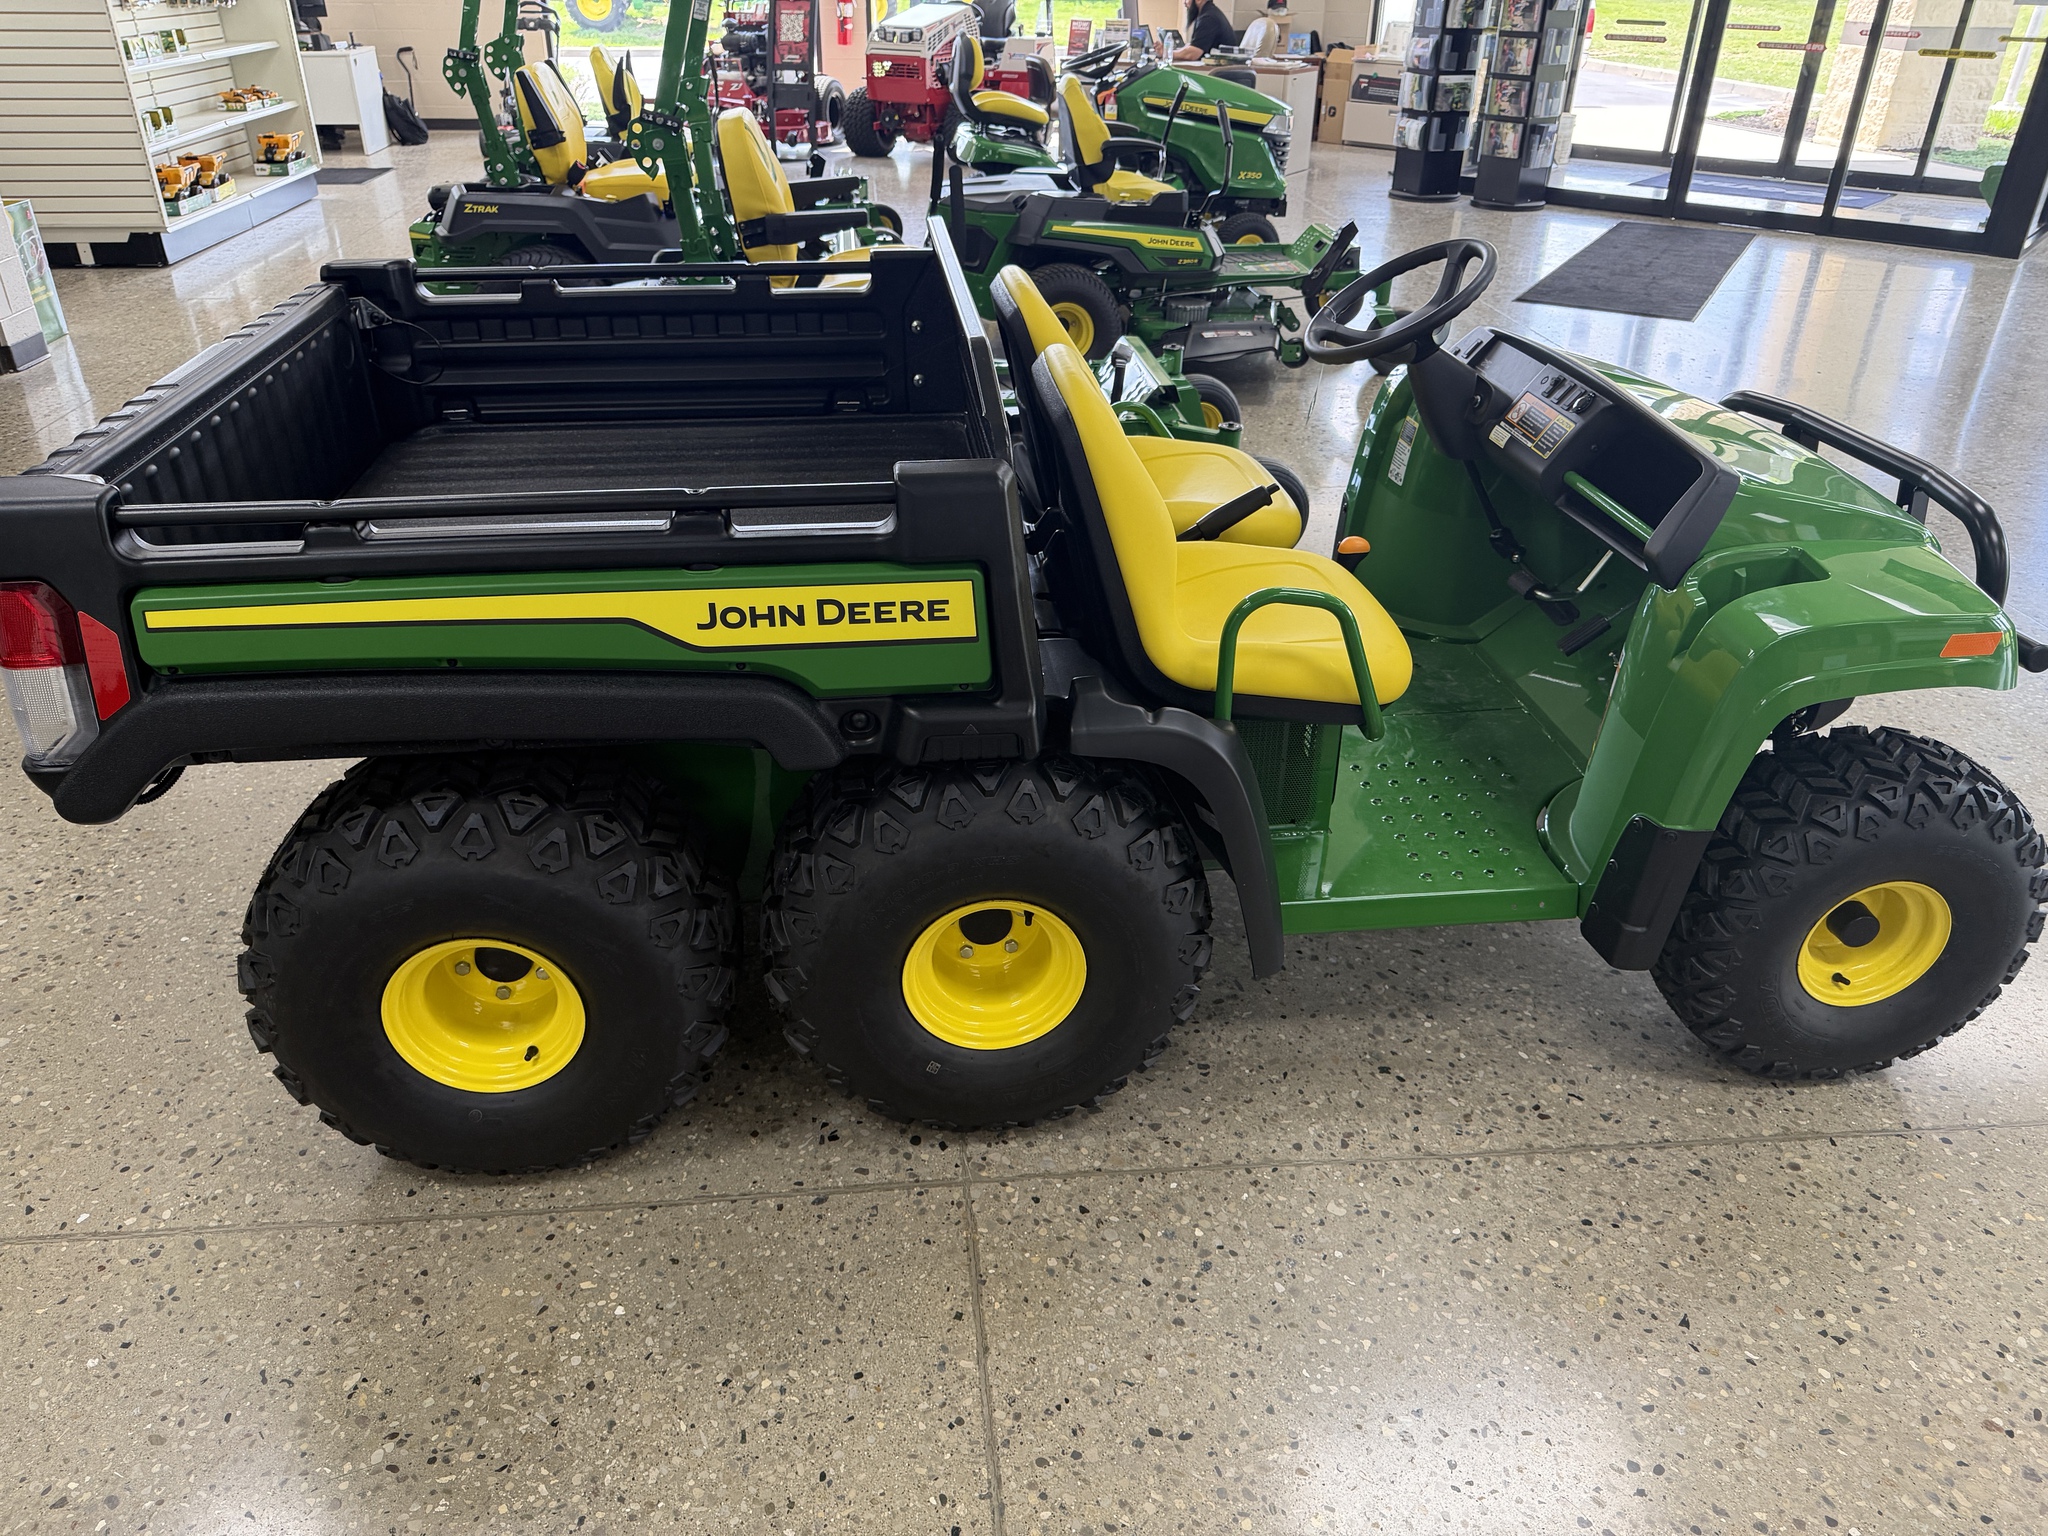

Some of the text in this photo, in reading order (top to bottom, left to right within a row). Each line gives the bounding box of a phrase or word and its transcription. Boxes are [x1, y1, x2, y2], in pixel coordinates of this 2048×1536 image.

[1184, 102, 1209, 114] DEERE
[1237, 170, 1263, 180] X350
[463, 203, 499, 214] ZTRAK
[1147, 237, 1195, 247] JOHN DEERE
[696, 598, 950, 630] JOHN DEERE
